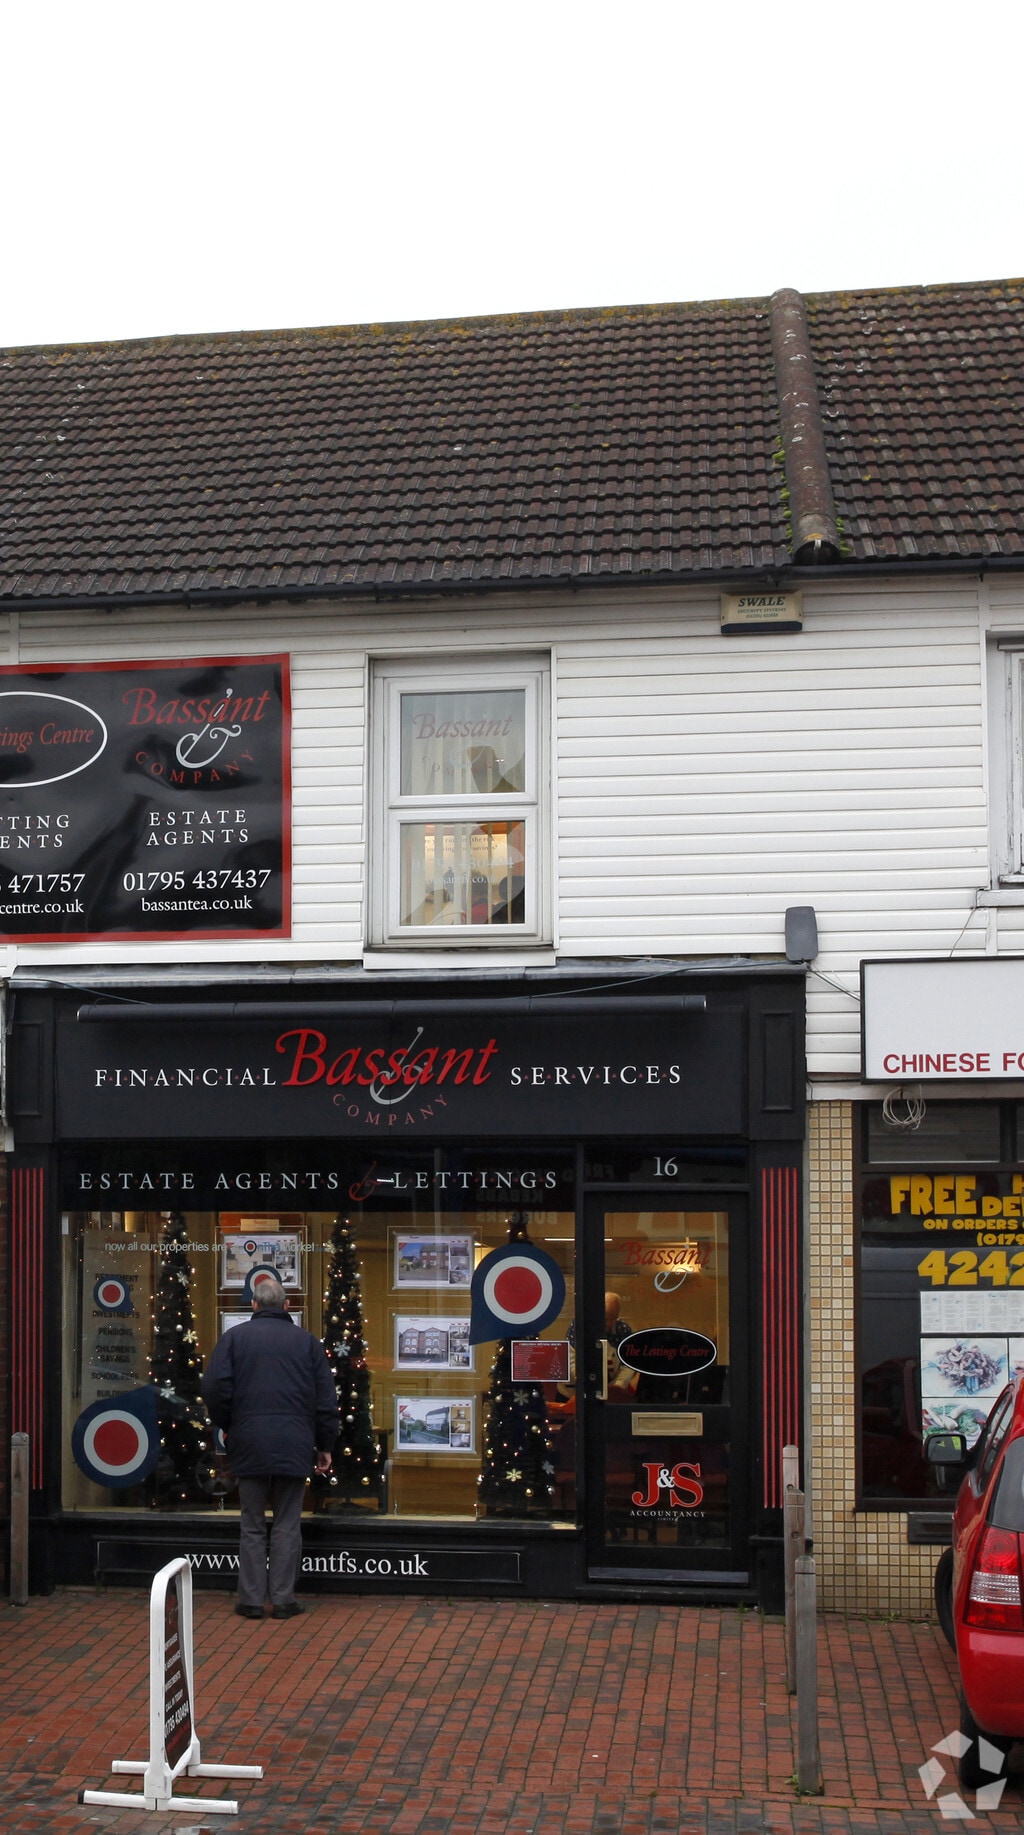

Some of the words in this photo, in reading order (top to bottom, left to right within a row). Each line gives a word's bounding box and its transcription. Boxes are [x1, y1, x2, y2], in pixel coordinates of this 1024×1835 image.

[738, 596, 786, 607] SWALE
[122, 687, 270, 725] Bassant
[40, 722, 94, 745] Centre
[412, 713, 514, 739] Bassant
[135, 750, 254, 784] COMPANY
[149, 809, 247, 827] ESTATE
[146, 829, 249, 846] AGENTS
[7, 873, 86, 893] 471757
[123, 871, 185, 891] 01795
[192, 869, 271, 890] 437437
[141, 895, 253, 912] bassantea.co.uk
[95, 1067, 276, 1087] FINANCIAL
[275, 1028, 499, 1088] Bassant
[510, 1065, 681, 1086] SERVICES
[883, 1053, 991, 1074] CHINESE
[332, 1093, 449, 1127] COMPANY
[653, 1156, 679, 1177] 16
[79, 1173, 195, 1191] ESTATE
[215, 1172, 339, 1190] AGENTS
[393, 1171, 557, 1189] LETTINGS
[890, 1175, 977, 1216] FREE
[923, 1219, 949, 1230] ON
[952, 1219, 1019, 1230] ORDERS
[104, 1243, 126, 1252] now
[127, 1241, 138, 1251] all
[140, 1242, 157, 1251] our
[159, 1241, 209, 1253] properties
[620, 1241, 714, 1266] Bassant
[98, 1328, 133, 1336] PENSIONS
[632, 1463, 703, 1508] J&S
[630, 1510, 705, 1518] ACCOUNTANCY
[184, 1551, 429, 1576] wwwantfs.co.uk
